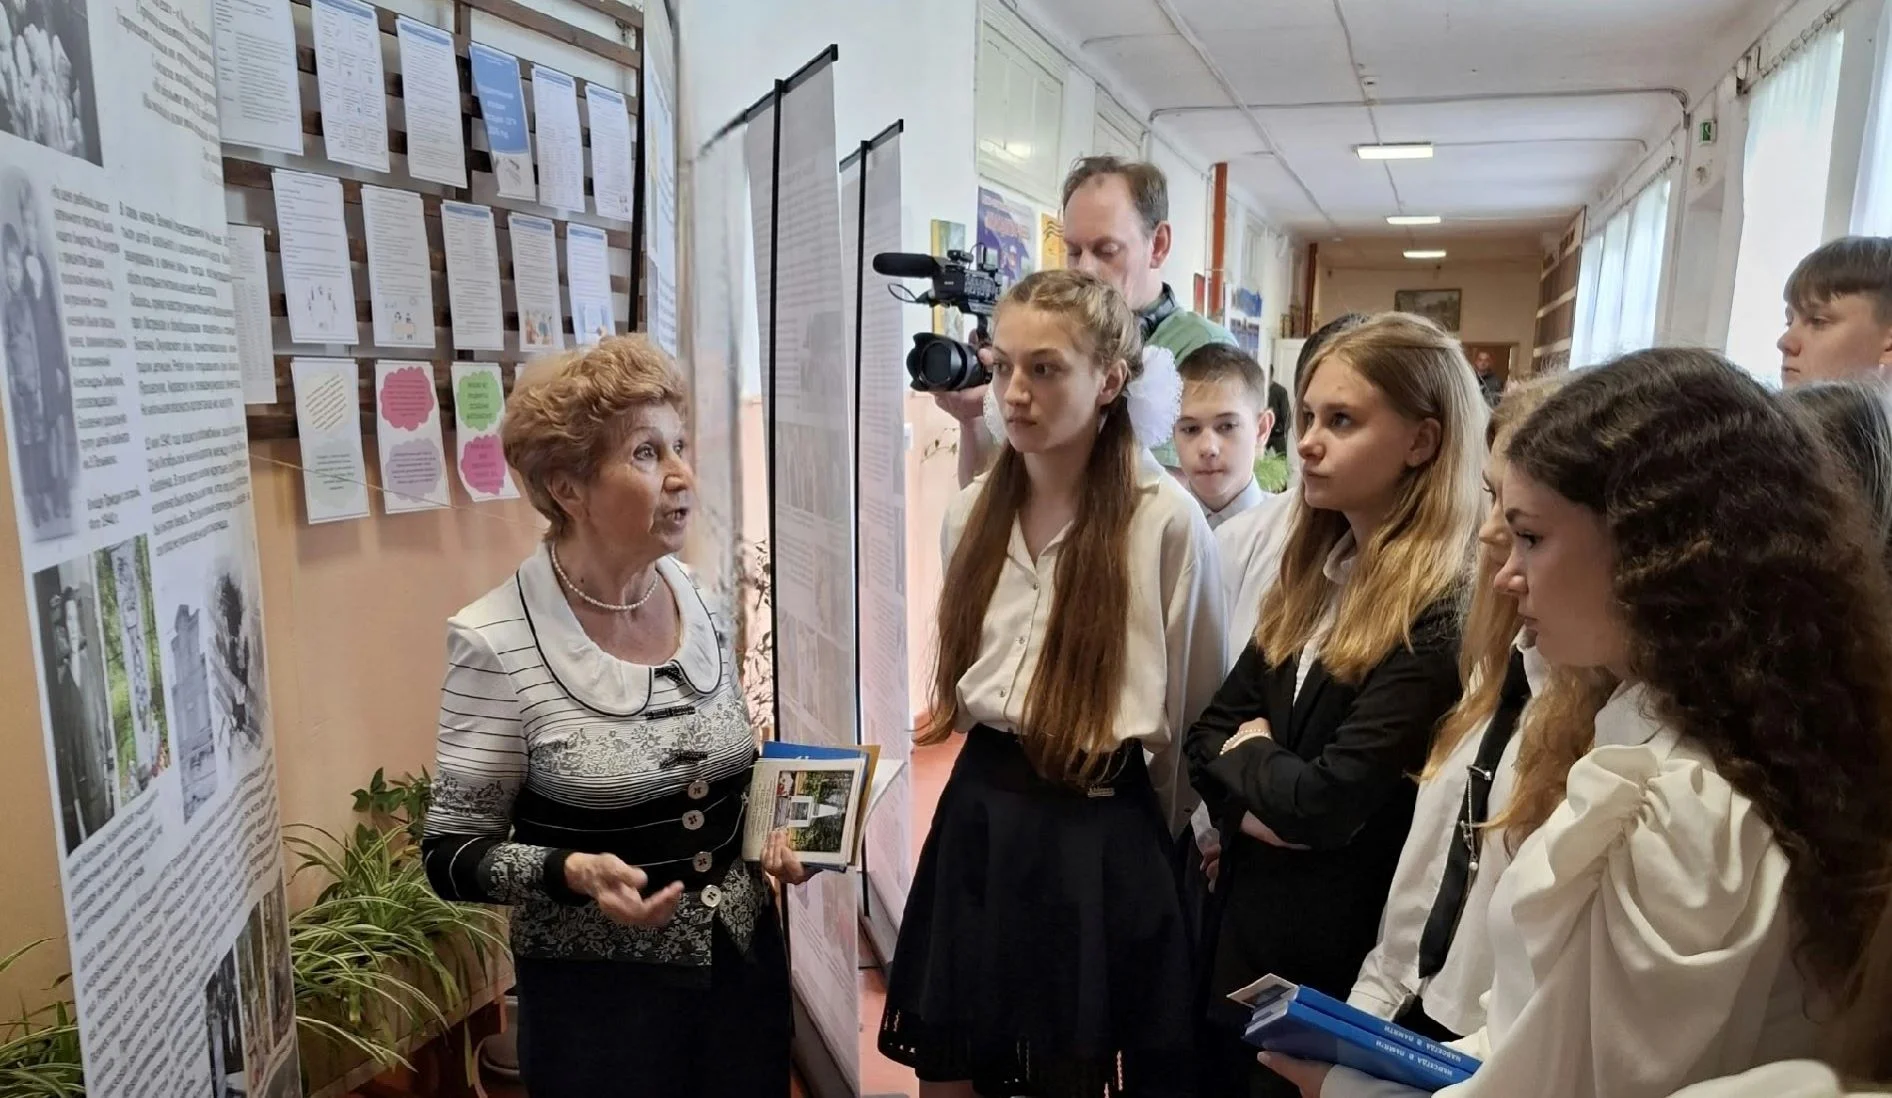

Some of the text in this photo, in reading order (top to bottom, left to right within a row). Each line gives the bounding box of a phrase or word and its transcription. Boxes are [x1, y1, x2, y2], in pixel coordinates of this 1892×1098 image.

[1384, 1025, 1414, 1042] ПАМЯТИ
[1426, 1043, 1462, 1062] НАВСЕГДА
[1417, 1056, 1453, 1076] НАВСЕГДА
